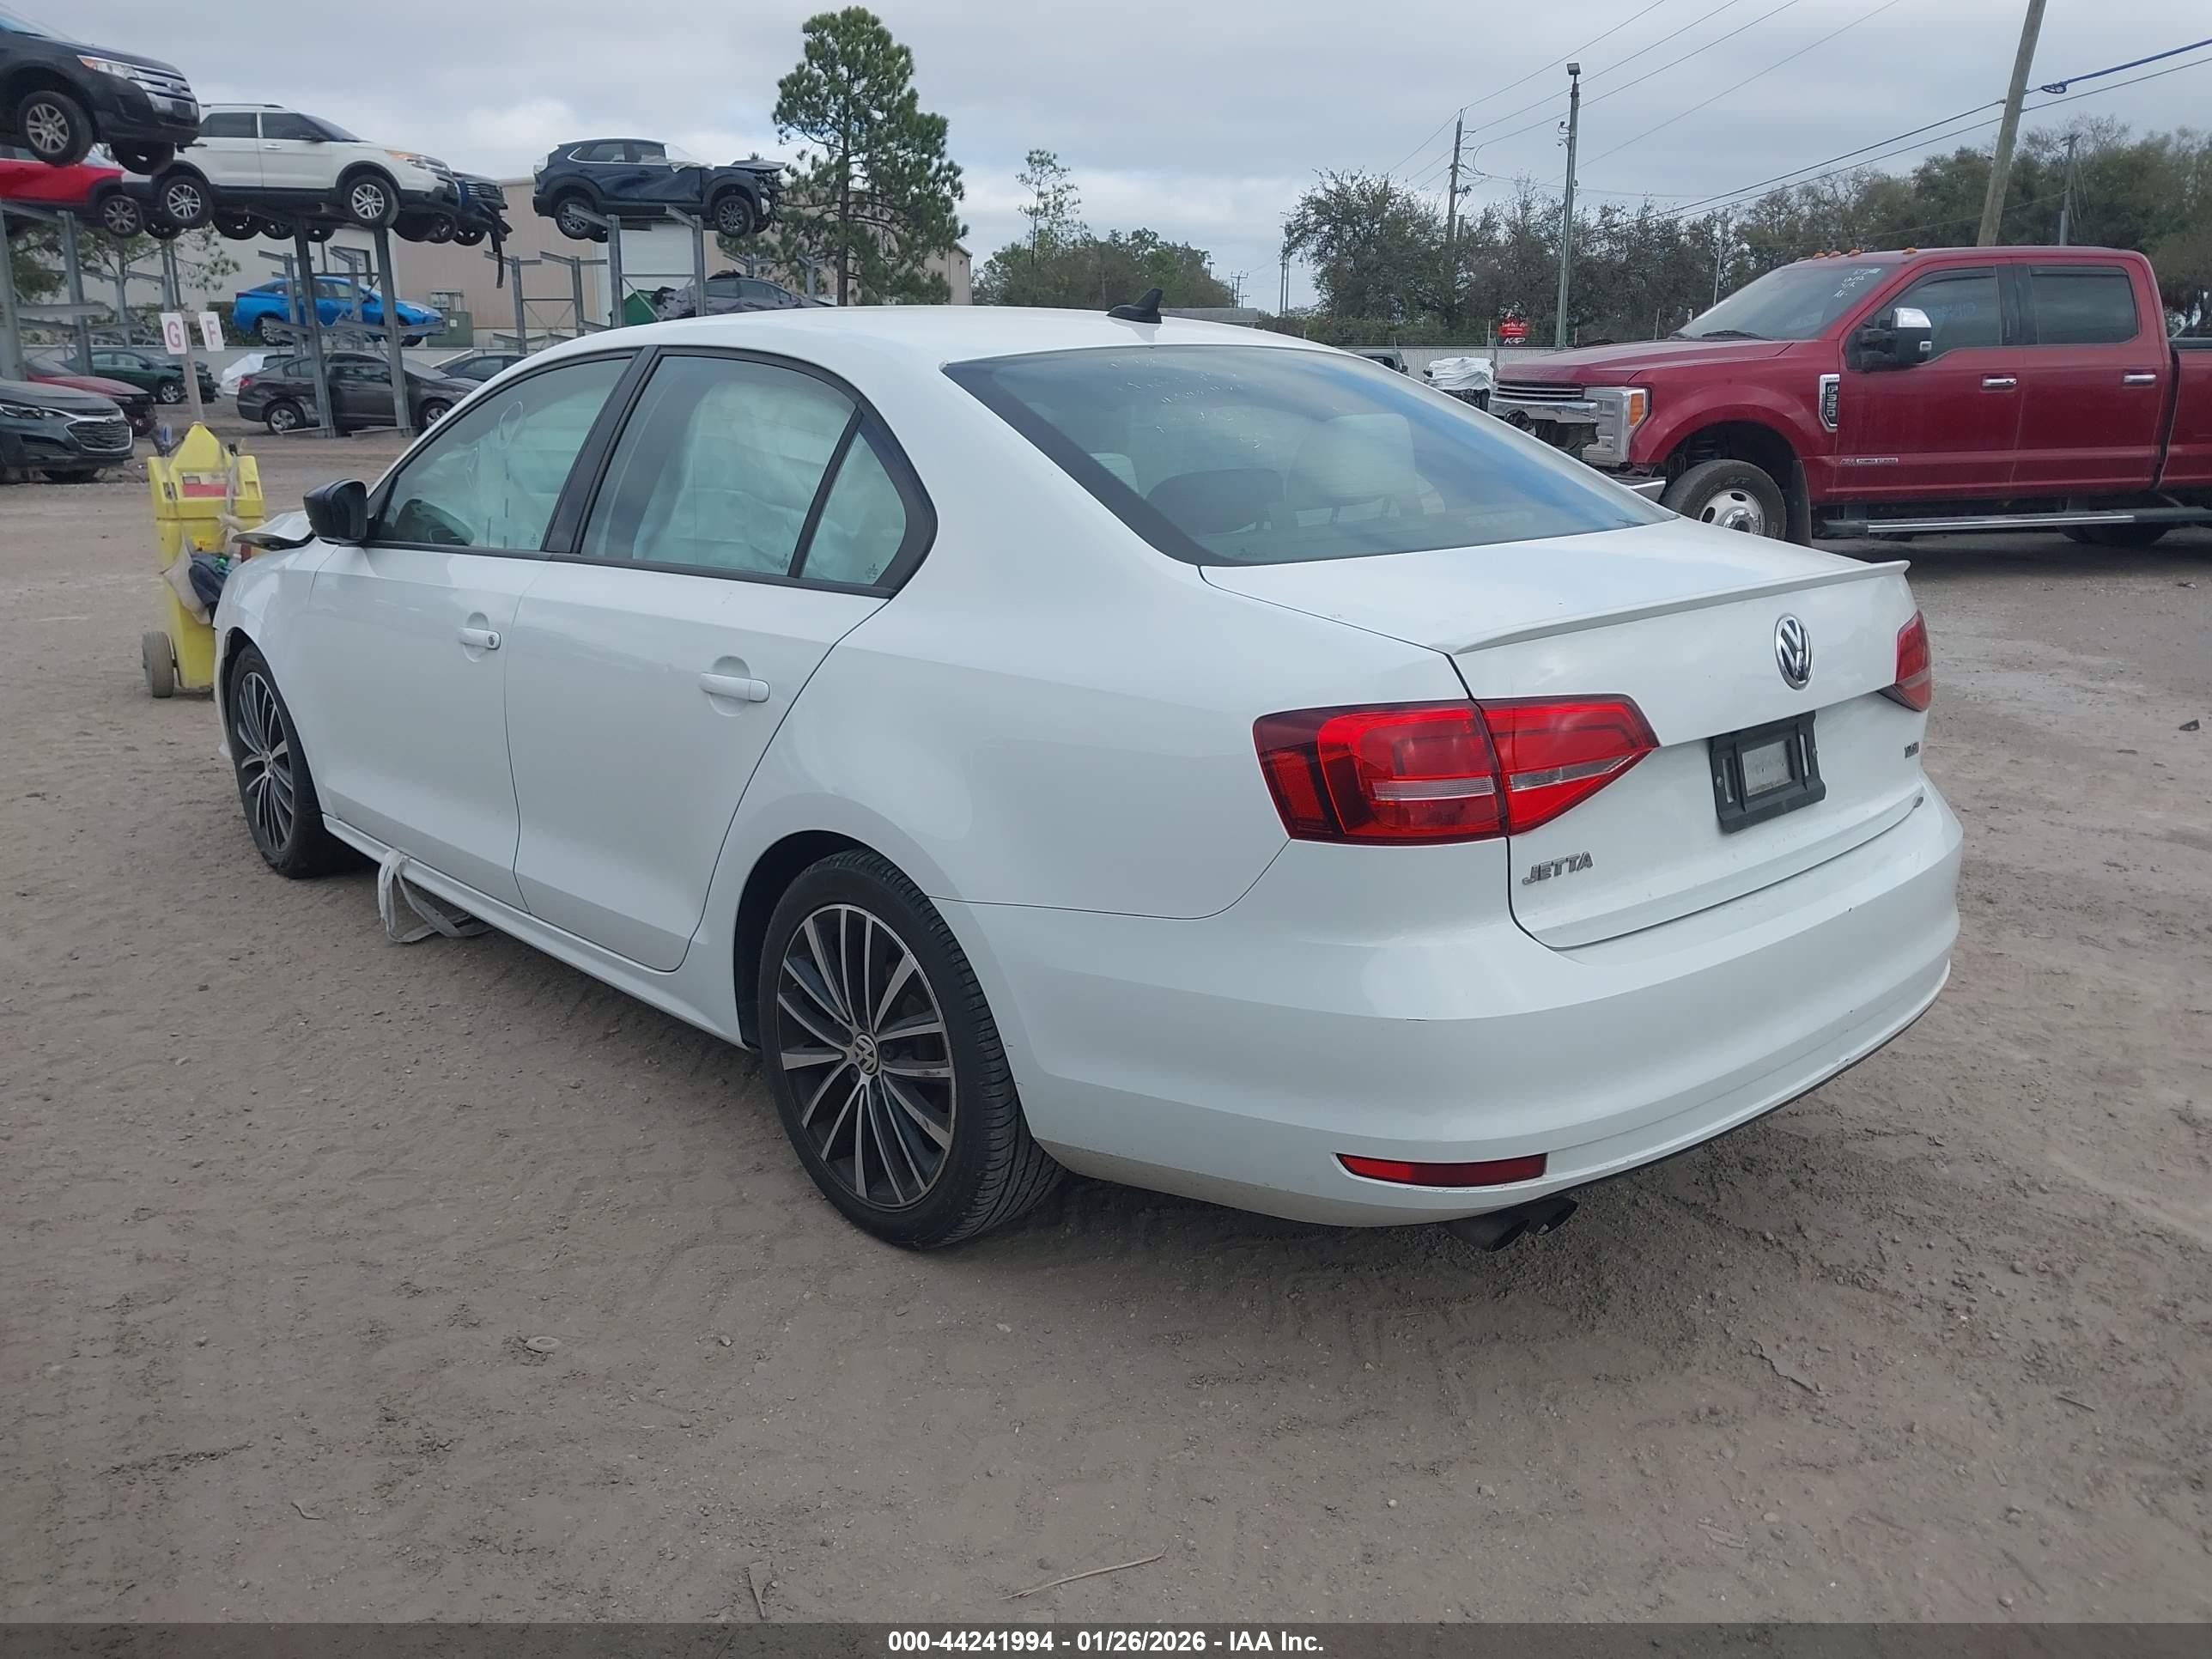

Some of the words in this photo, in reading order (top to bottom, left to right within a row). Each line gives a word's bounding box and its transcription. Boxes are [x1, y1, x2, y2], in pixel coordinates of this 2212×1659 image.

[167, 319, 182, 349] G
[205, 319, 216, 346] F
[1522, 850, 1594, 885] JETTA
